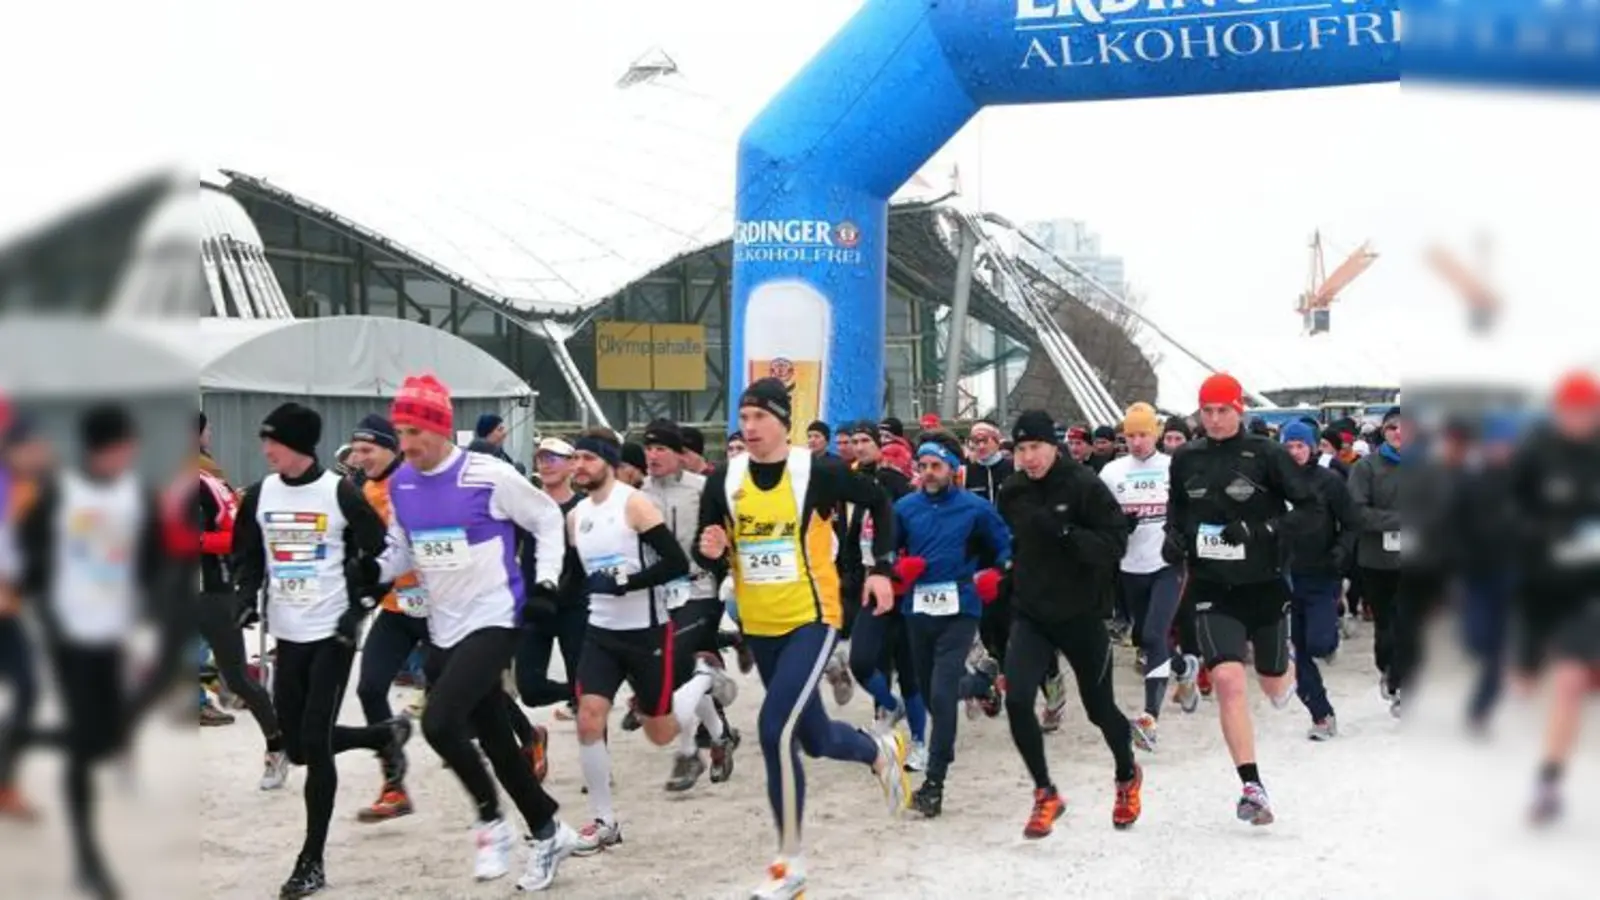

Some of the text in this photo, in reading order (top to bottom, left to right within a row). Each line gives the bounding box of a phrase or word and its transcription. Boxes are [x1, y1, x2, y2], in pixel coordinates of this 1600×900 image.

[734, 219, 834, 246] RDINGER
[423, 541, 454, 556] 904
[749, 554, 782, 569] 240
